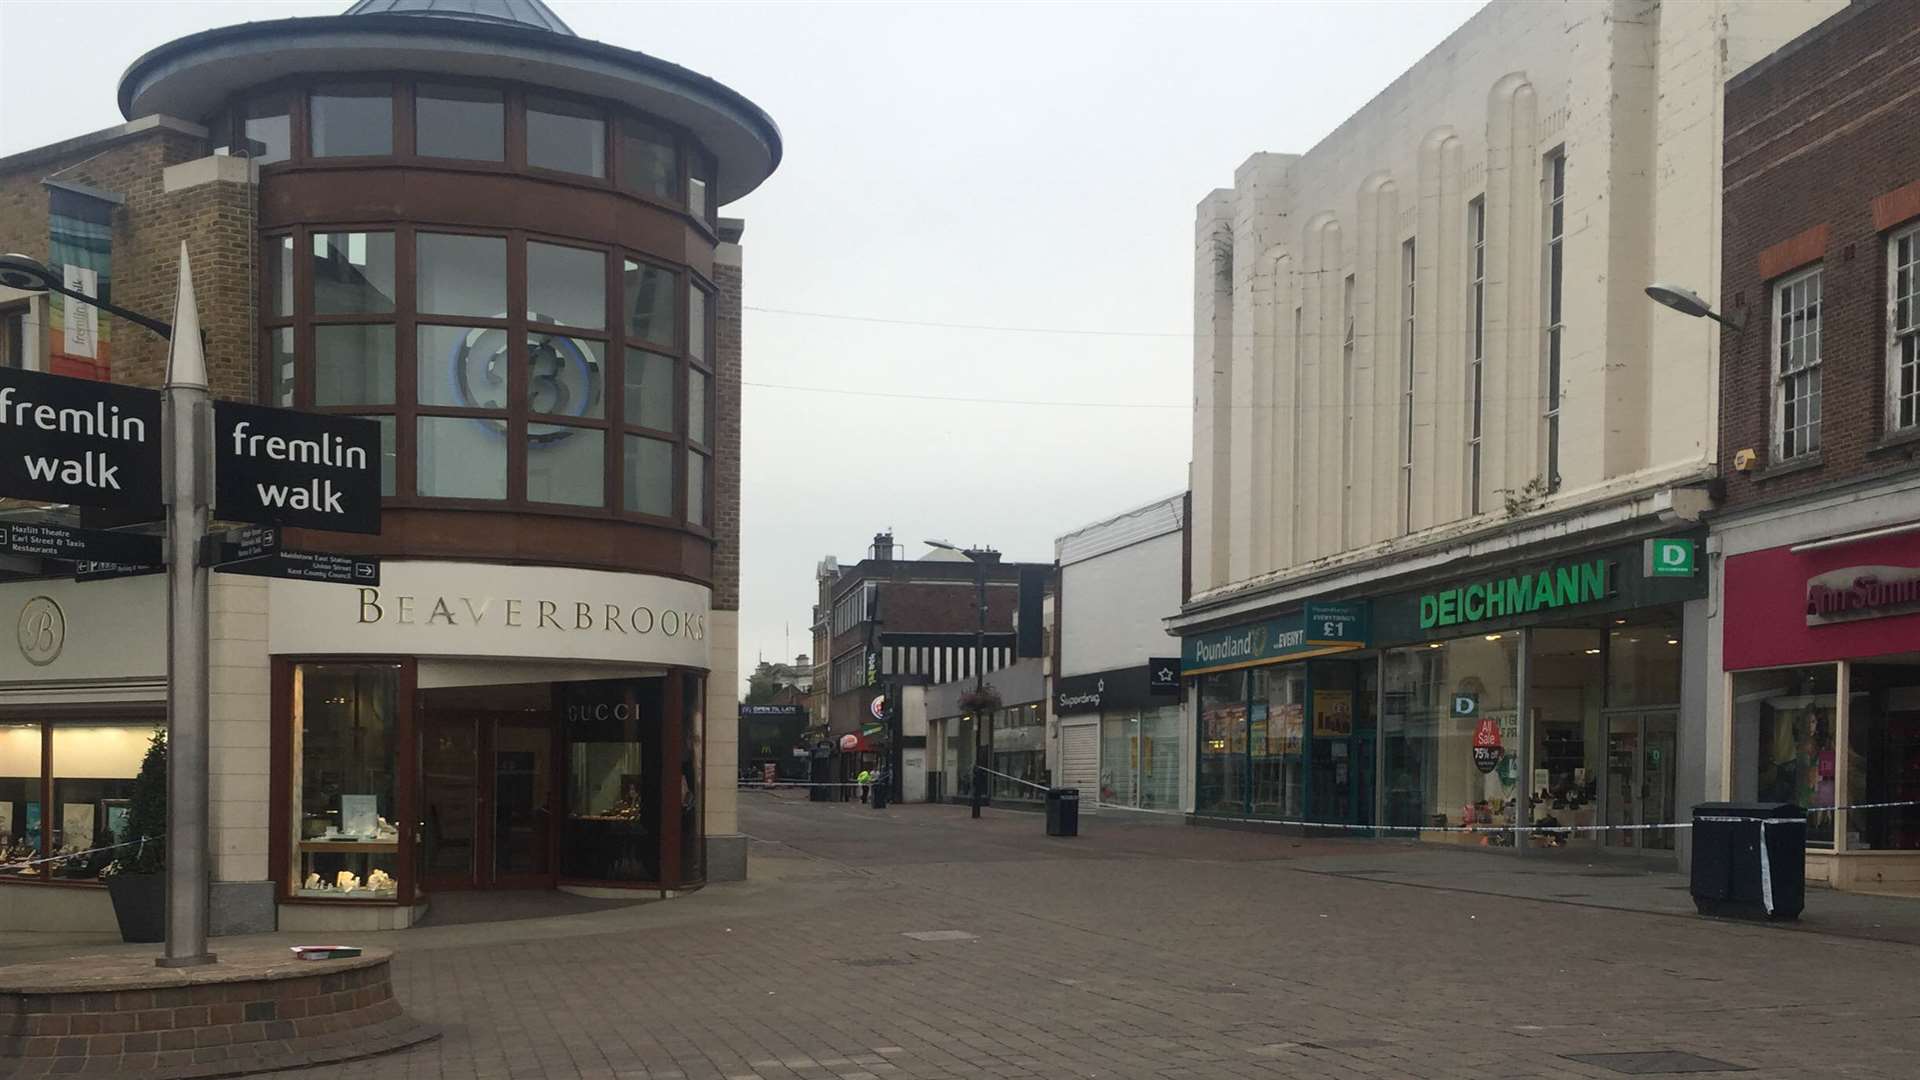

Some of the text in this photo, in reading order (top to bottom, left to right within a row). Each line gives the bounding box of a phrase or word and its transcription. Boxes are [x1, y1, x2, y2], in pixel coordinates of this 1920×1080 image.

[0, 386, 146, 443] fremlin
[233, 421, 367, 470] fremlin
[24, 451, 121, 490] walk
[256, 478, 345, 514] walk
[12, 535, 28, 544] Earl
[30, 536, 54, 545] Street
[66, 539, 85, 548] Taxis
[41, 528, 70, 537] Theatre
[12, 543, 58, 555] Restaurants
[280, 551, 313, 560] Maidstone
[1663, 545, 1686, 566] D
[304, 569, 327, 578] County
[328, 570, 351, 579] Council
[1419, 559, 1605, 630] DEICHMANN
[358, 587, 704, 641] BEAVERBROOKS
[1323, 621, 1344, 637] £1
[1195, 631, 1252, 663] Poundland
[1060, 691, 1101, 708] Superdrug
[1455, 698, 1474, 715] D
[568, 703, 641, 722] GUCCI
[1478, 732, 1496, 745] Sale
